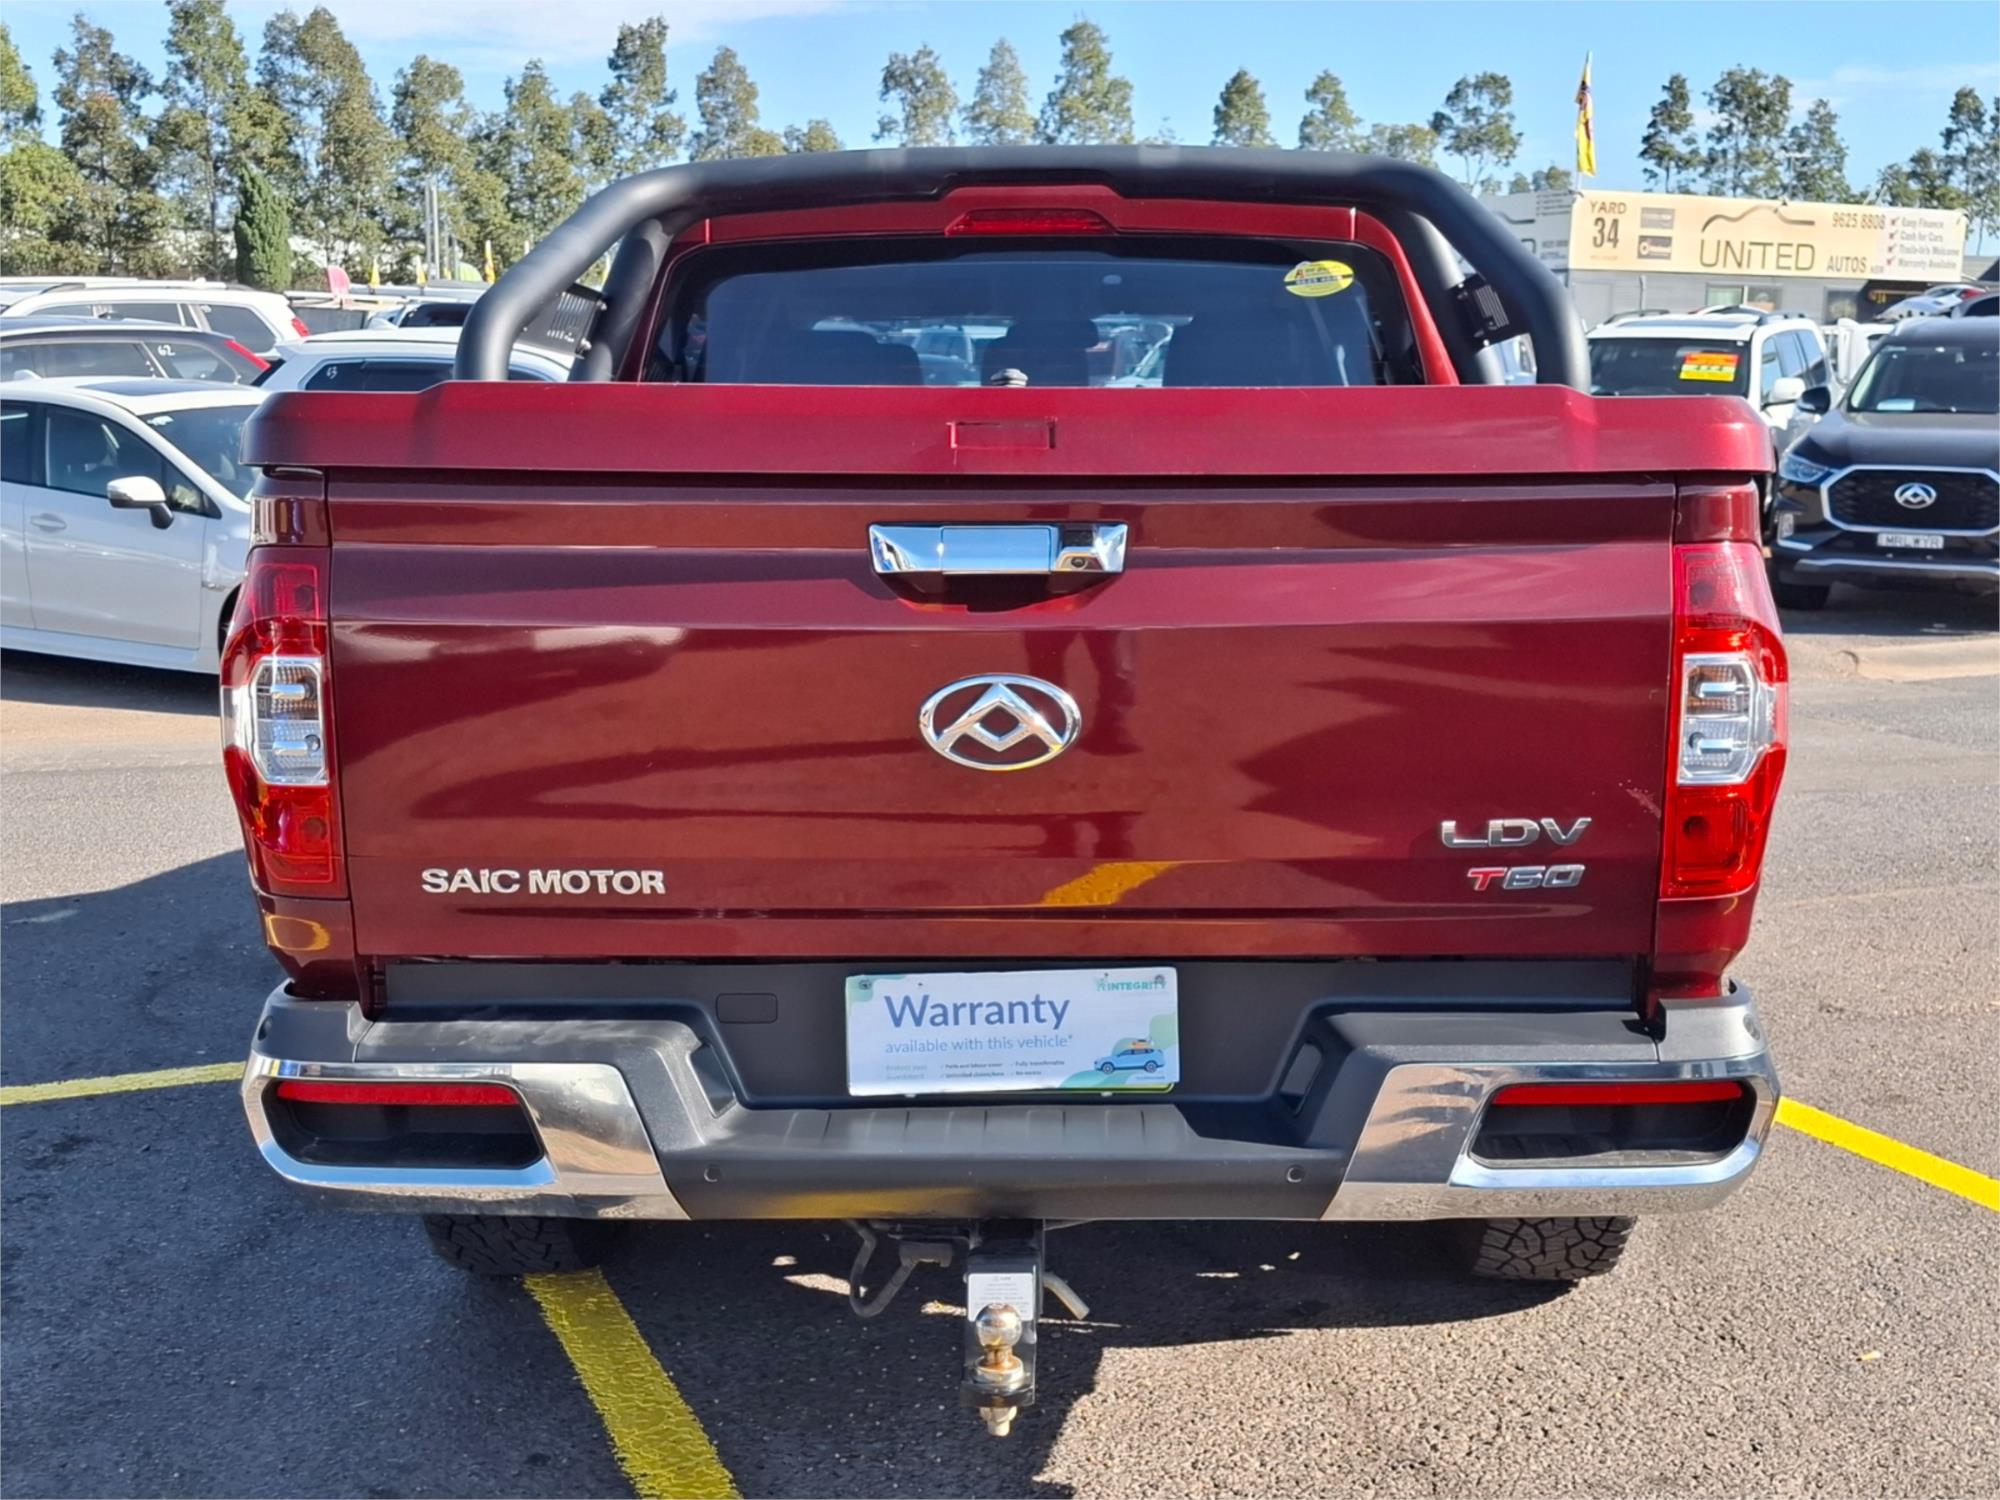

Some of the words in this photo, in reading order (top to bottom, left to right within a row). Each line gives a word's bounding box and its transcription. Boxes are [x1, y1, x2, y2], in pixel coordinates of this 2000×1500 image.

[1589, 200, 1627, 215] YARD
[1832, 212, 1858, 228] 9625
[1592, 217, 1620, 249] 34
[1826, 255, 1868, 274] AUTOS
[1441, 817, 1592, 848] LDV
[421, 867, 521, 894] SAIC
[528, 869, 667, 895] MOTOR
[1467, 864, 1585, 891] T60
[883, 993, 1071, 1030] Warranty
[885, 1038, 948, 1054] available
[951, 1037, 984, 1051] with
[987, 1036, 1014, 1050] this
